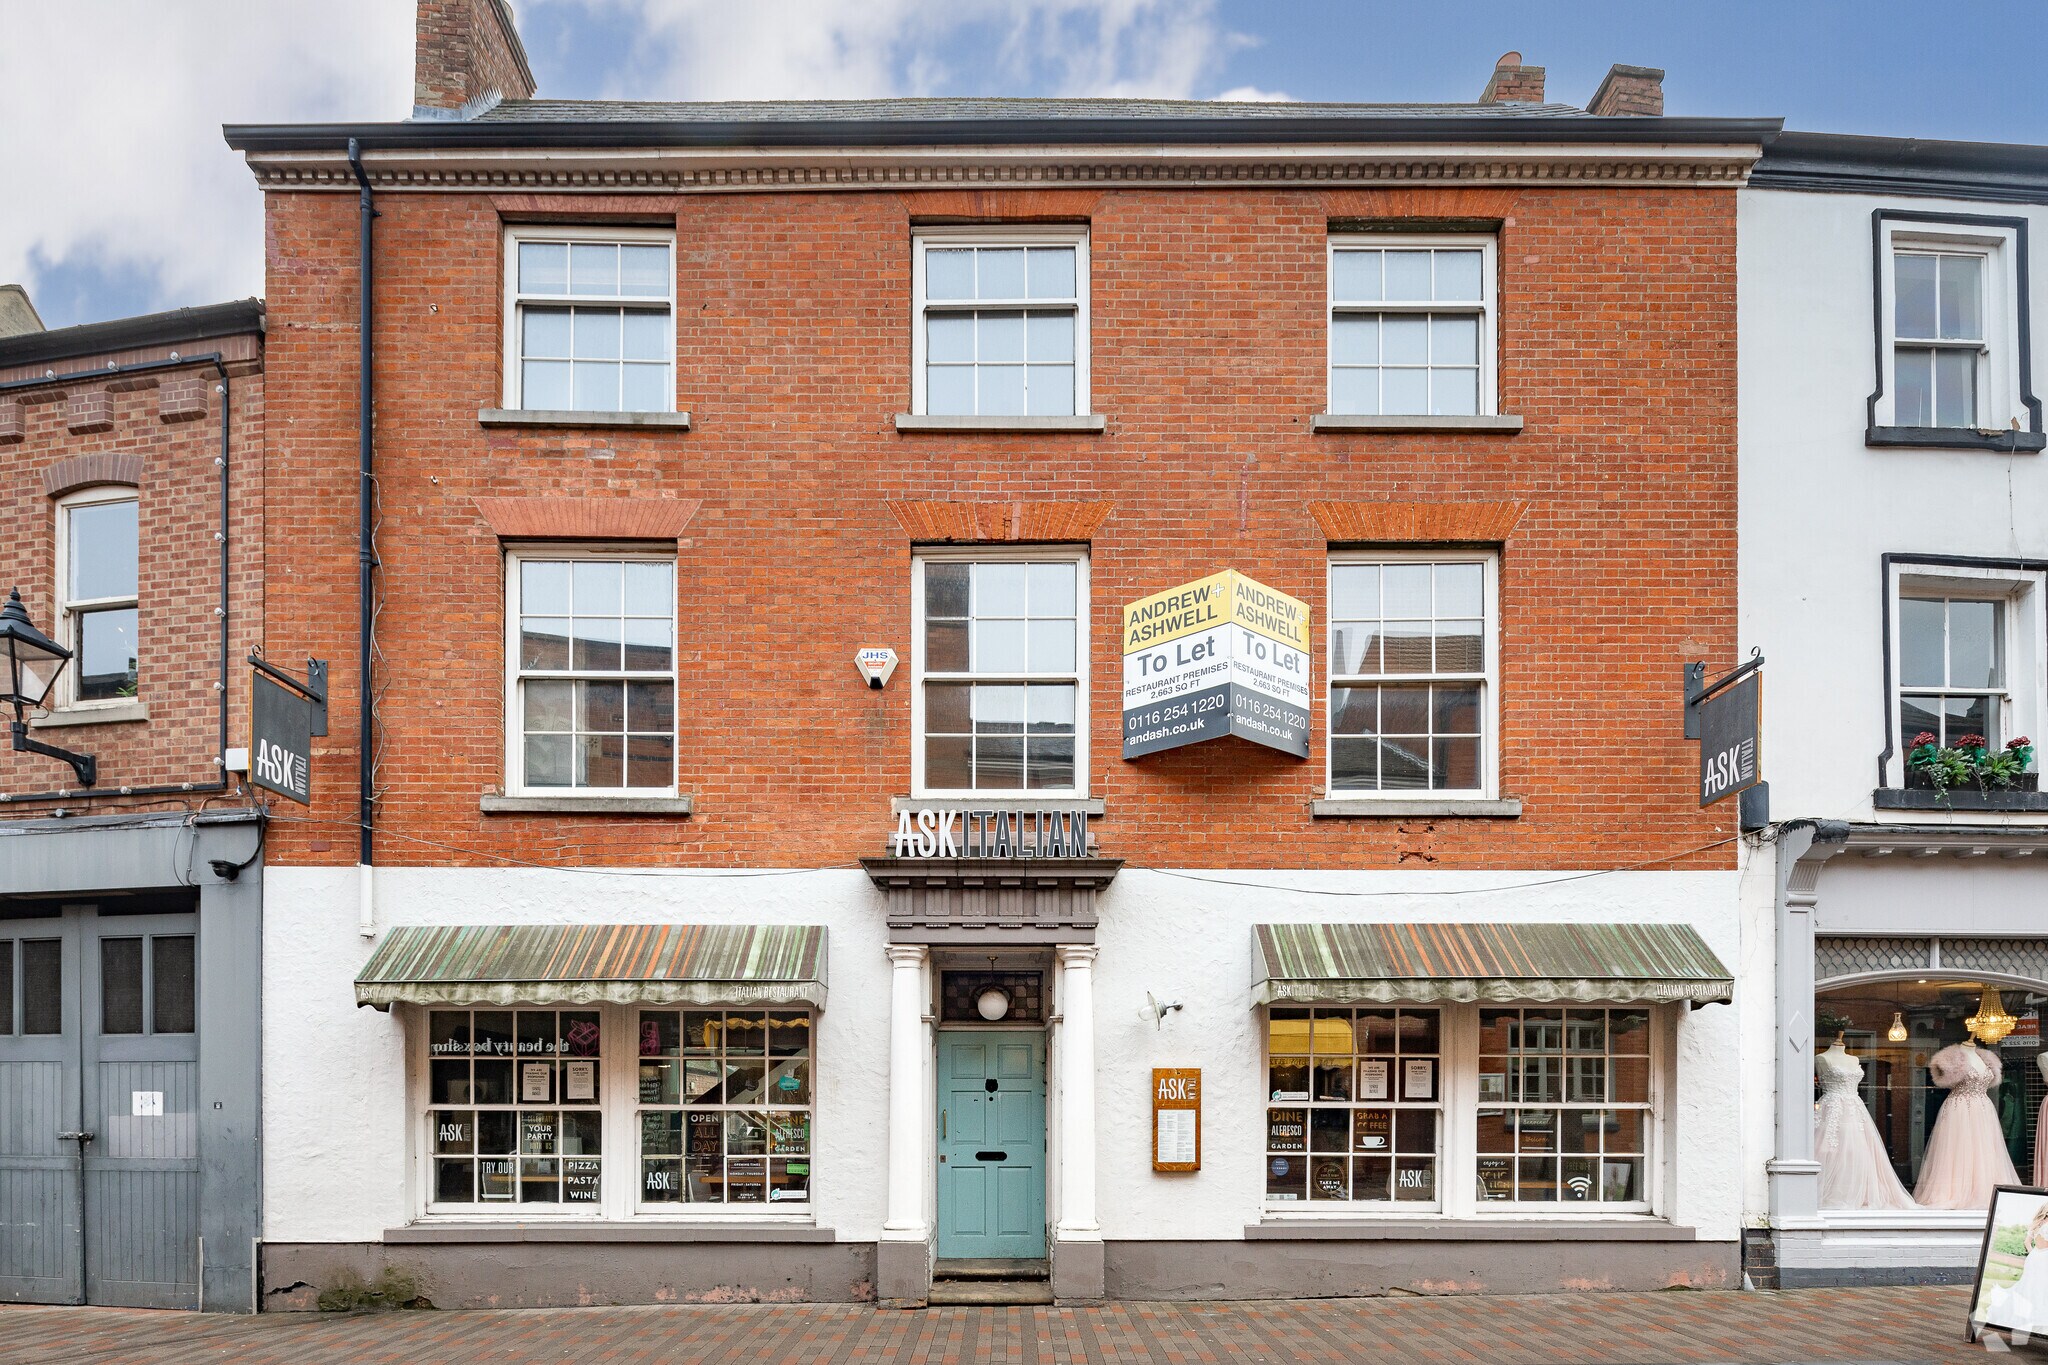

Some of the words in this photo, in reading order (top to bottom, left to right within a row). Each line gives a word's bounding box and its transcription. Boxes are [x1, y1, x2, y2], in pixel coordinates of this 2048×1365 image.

[1129, 605, 1217, 646] ASHWELL
[1236, 602, 1301, 643] ASHWELL
[1138, 653, 1167, 676] To
[1177, 636, 1215, 666] Let
[1243, 631, 1266, 660] To
[1273, 643, 1299, 674] Let
[1126, 676, 1180, 697] RESTAURANT
[1183, 662, 1228, 681] PREMISES
[1175, 683, 1187, 693] SQ
[1190, 679, 1200, 688] FT
[1233, 661, 1276, 684] RESTAURANT
[1277, 678, 1308, 696] PREMISES
[1272, 685, 1281, 695] SQ
[1283, 689, 1290, 697] FT
[1129, 711, 1160, 730] 0116
[1164, 702, 1188, 721] 254
[1192, 694, 1224, 713] 1220
[1236, 694, 1260, 714] 0116
[1263, 706, 1281, 721] 254
[1283, 712, 1305, 729] 1220
[1129, 718, 1205, 745] andash.co.uk
[1236, 715, 1292, 740] andash.co.uk
[257, 738, 294, 790] ASK
[295, 754, 306, 795] ITALIAN
[1704, 744, 1740, 797] ASK
[1741, 737, 1753, 781] ITALIAN
[894, 809, 957, 857] ASK
[962, 809, 1087, 857] ITALIAN
[764, 987, 808, 997] RESTAURANT
[1277, 985, 1291, 996] ASK
[1657, 985, 1684, 996] ITALIAN
[1686, 985, 1729, 995] RESTAURANT
[1158, 1078, 1186, 1099] ASK
[691, 1114, 719, 1122] OPEN
[1272, 1112, 1302, 1122] DINE
[440, 1124, 462, 1141] ASK
[693, 1126, 717, 1138] ALL
[1271, 1125, 1302, 1136] ALFRESCO
[692, 1140, 718, 1152] DAY
[482, 1162, 495, 1174] TRY
[498, 1162, 514, 1174] OUR
[568, 1162, 598, 1170] PIZZA
[647, 1172, 669, 1189] ASK
[1399, 1170, 1422, 1188] ASK
[570, 1191, 597, 1199] WINE
